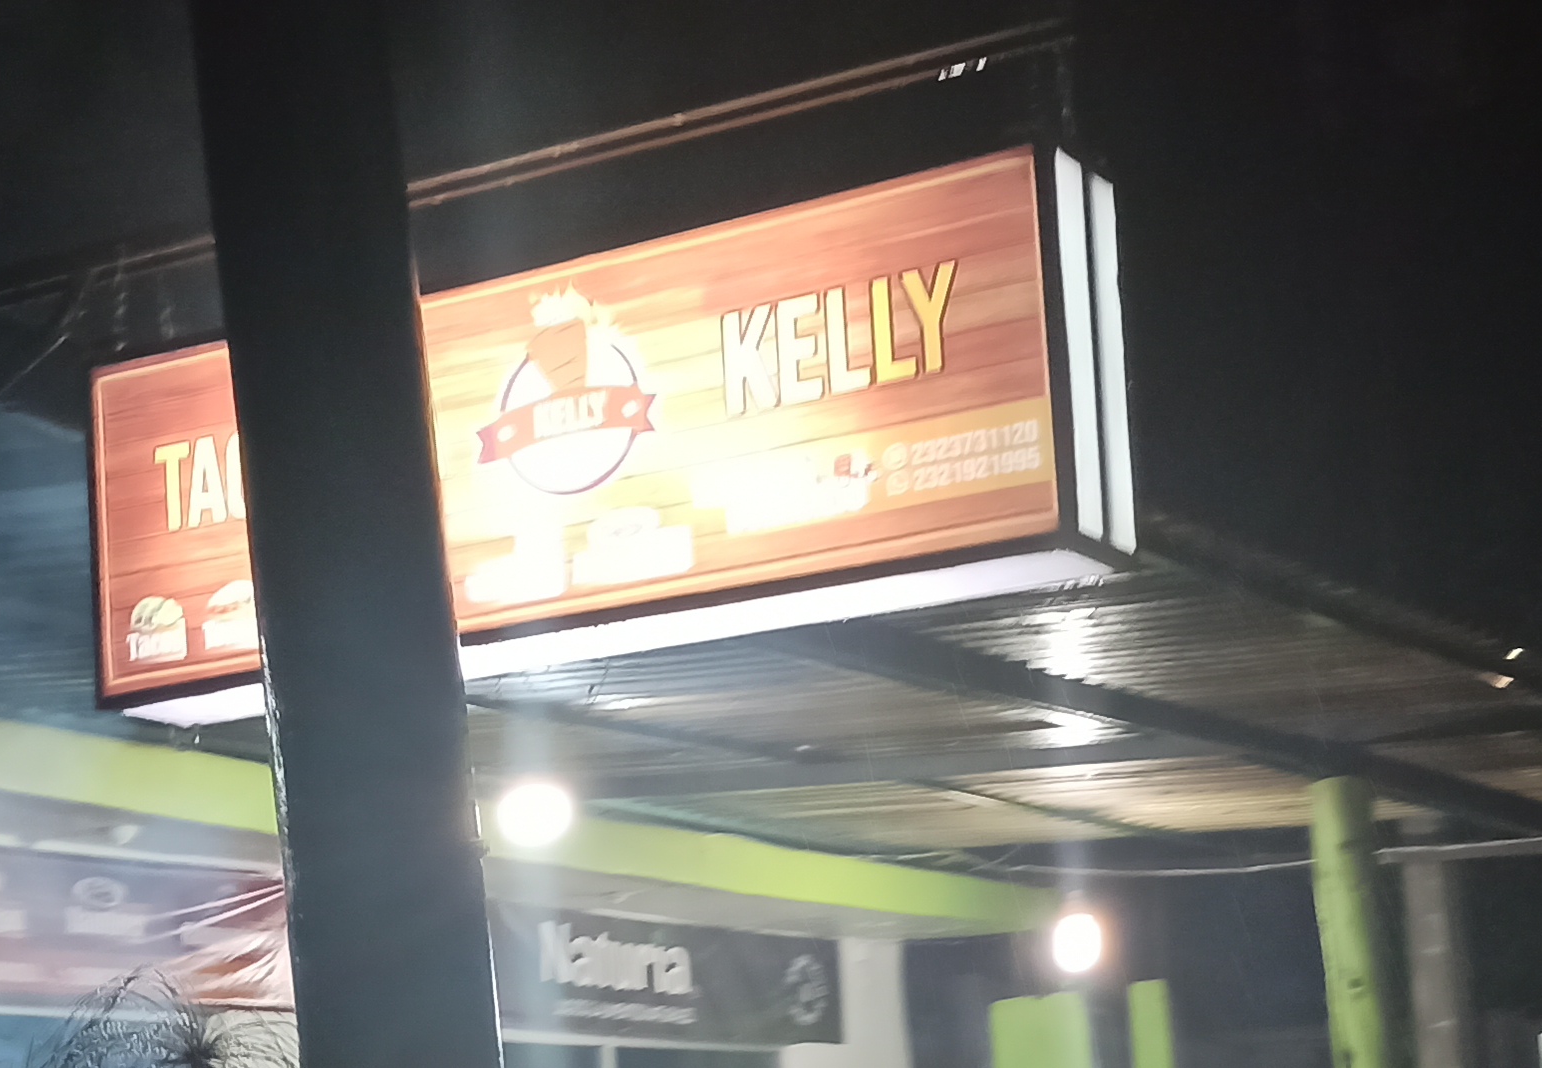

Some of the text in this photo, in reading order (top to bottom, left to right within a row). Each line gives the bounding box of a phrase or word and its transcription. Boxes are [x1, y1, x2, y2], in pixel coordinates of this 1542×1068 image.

[720, 258, 958, 418] KELLY
[532, 390, 608, 441] KELLY
[910, 418, 1039, 467] 2323731120
[153, 430, 247, 533] TAC
[912, 446, 1041, 492] 2321921995
